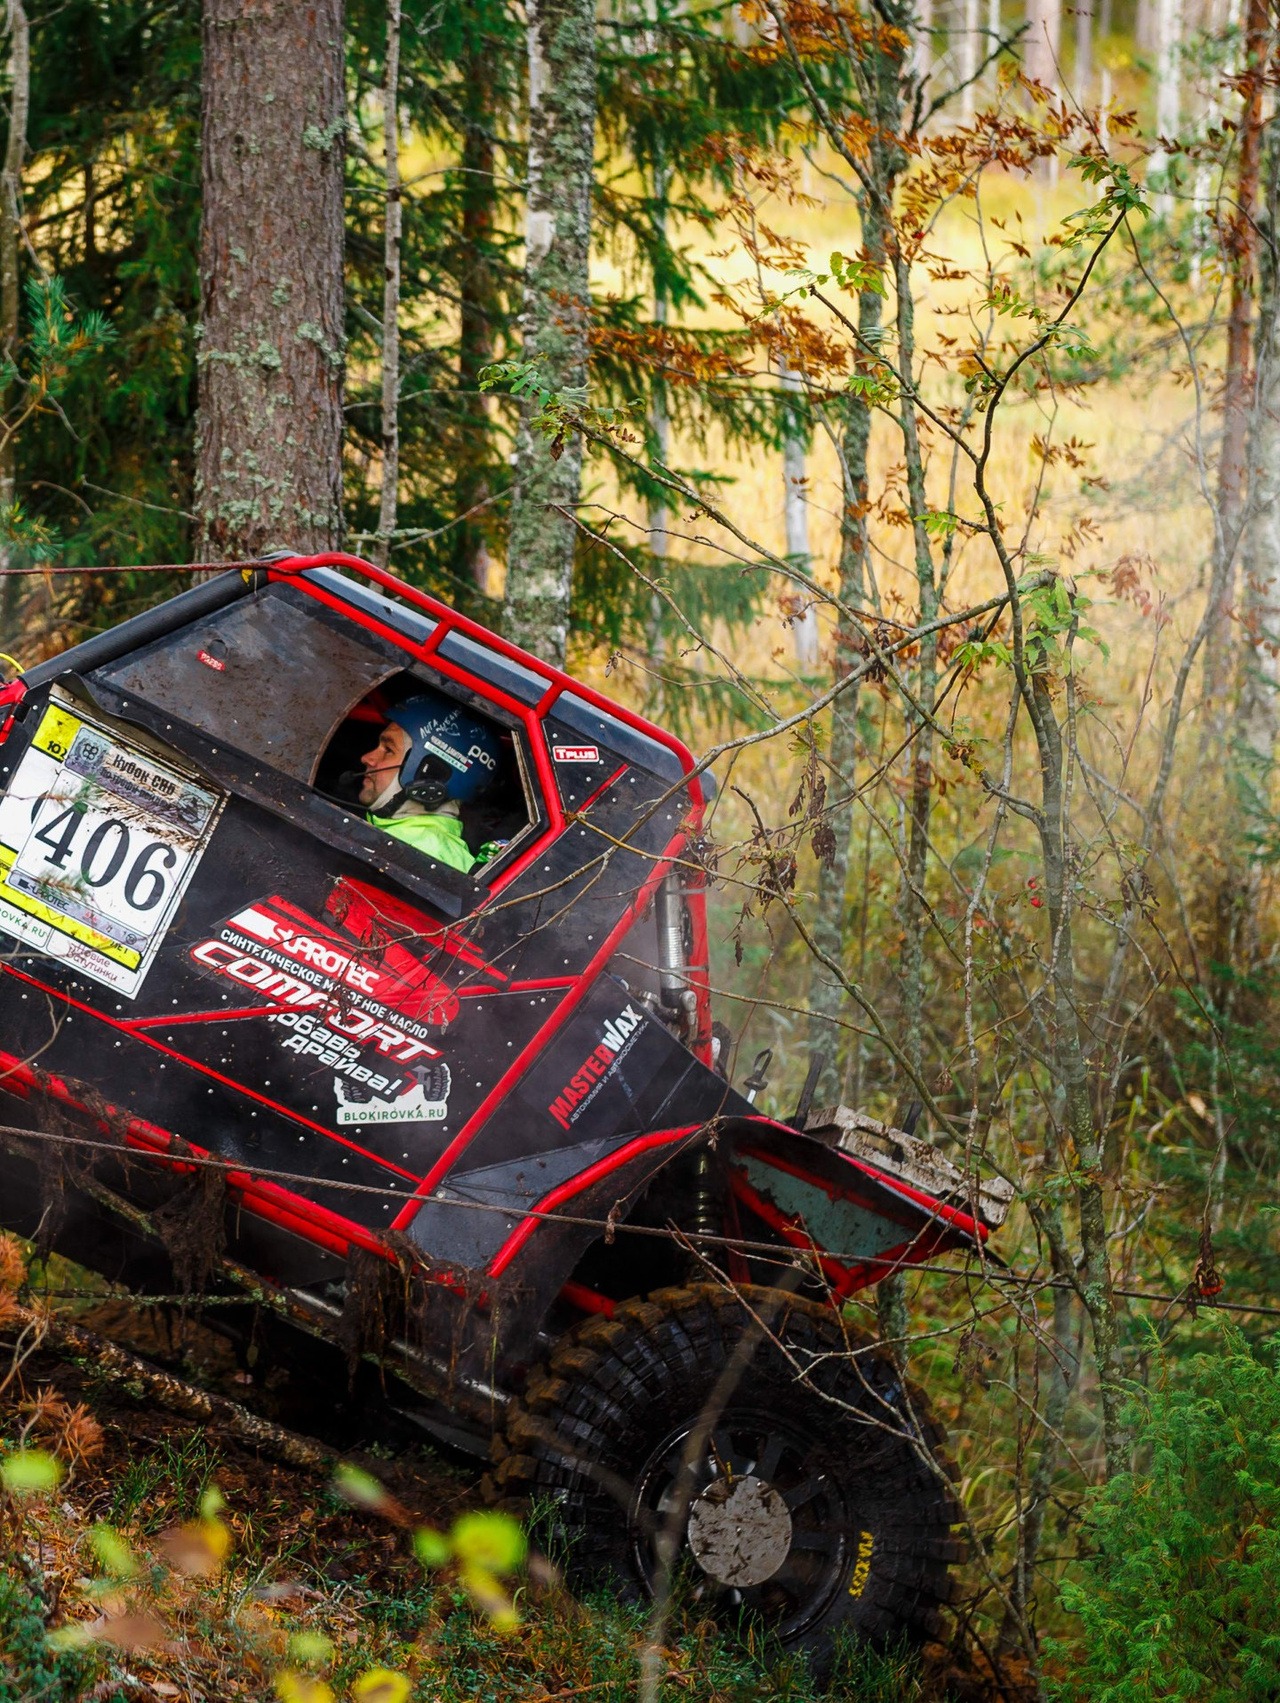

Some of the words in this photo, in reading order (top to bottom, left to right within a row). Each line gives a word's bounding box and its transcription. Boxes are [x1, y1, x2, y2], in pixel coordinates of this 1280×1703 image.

[34, 803, 177, 912] 406
[270, 924, 380, 992] SUPROTEC
[281, 1033, 401, 1096] драйва!
[548, 1004, 643, 1130] MASTERWAX
[344, 1108, 444, 1122] BLOKIROVKA.RU
